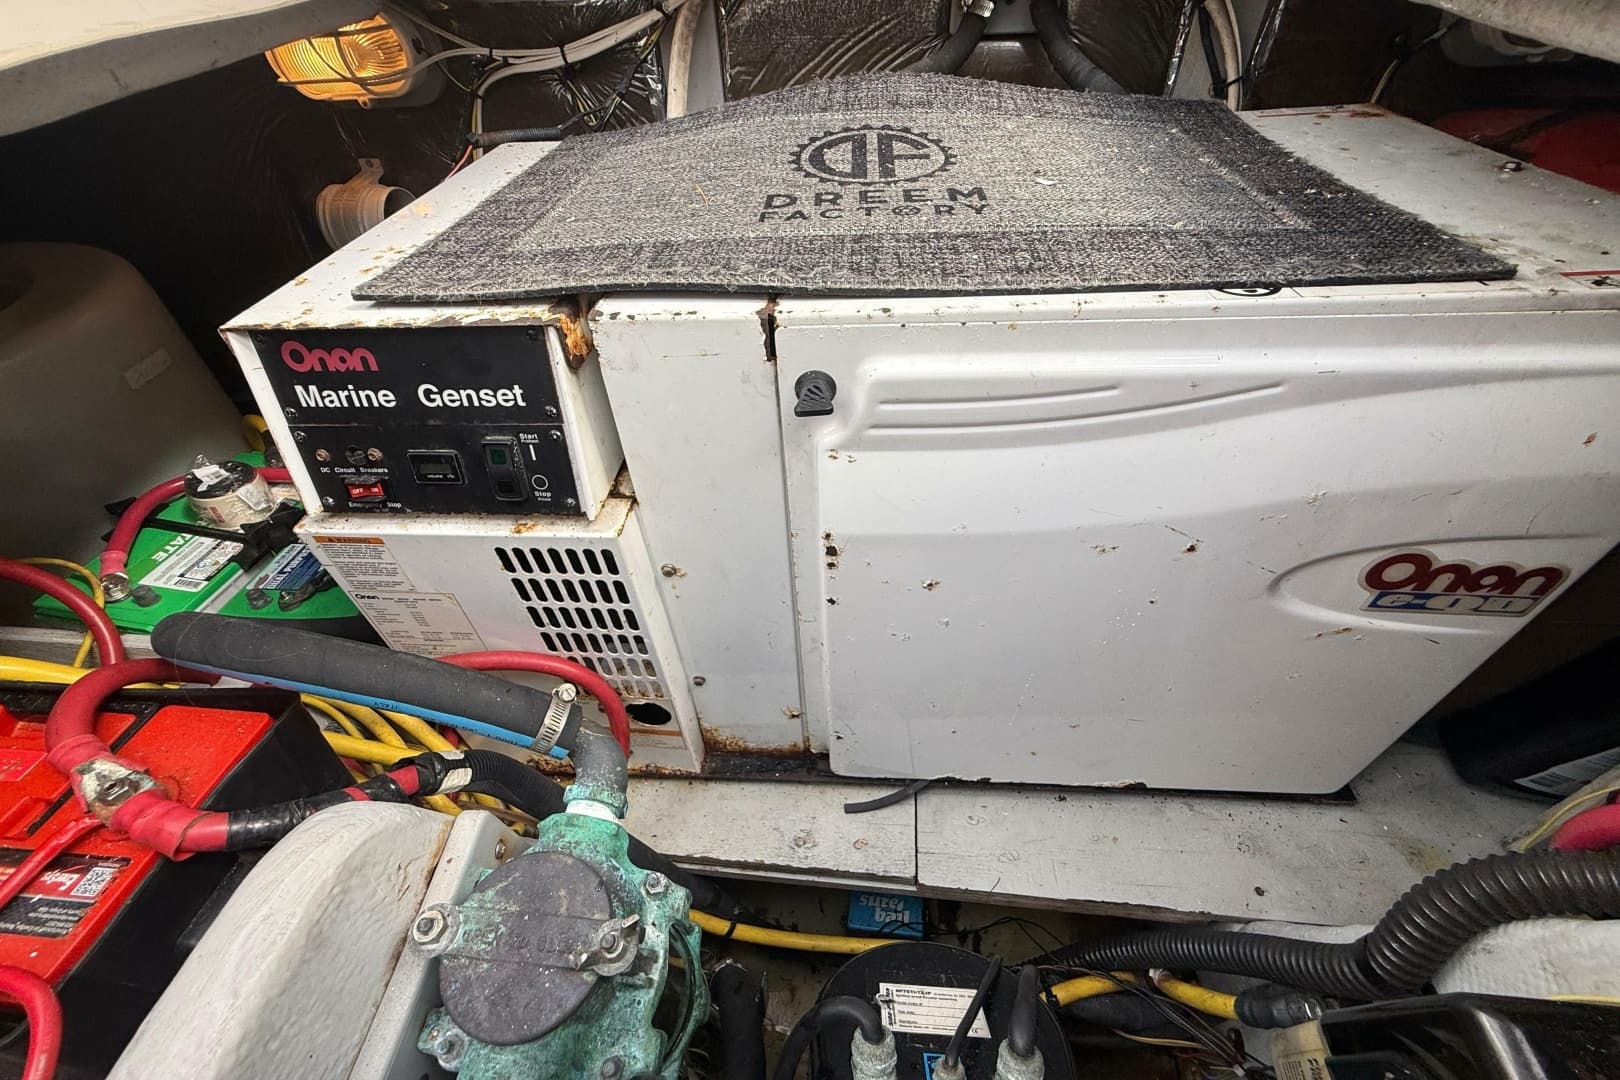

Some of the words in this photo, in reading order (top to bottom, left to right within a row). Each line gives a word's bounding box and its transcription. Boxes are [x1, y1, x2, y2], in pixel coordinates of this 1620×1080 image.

[763, 186, 988, 209] DREEM
[758, 203, 988, 223] FACTORY
[281, 341, 379, 372] Onan
[294, 385, 397, 408] Marine
[417, 383, 526, 408] Genset
[1365, 553, 1563, 595] Onan
[859, 894, 898, 908] sure
